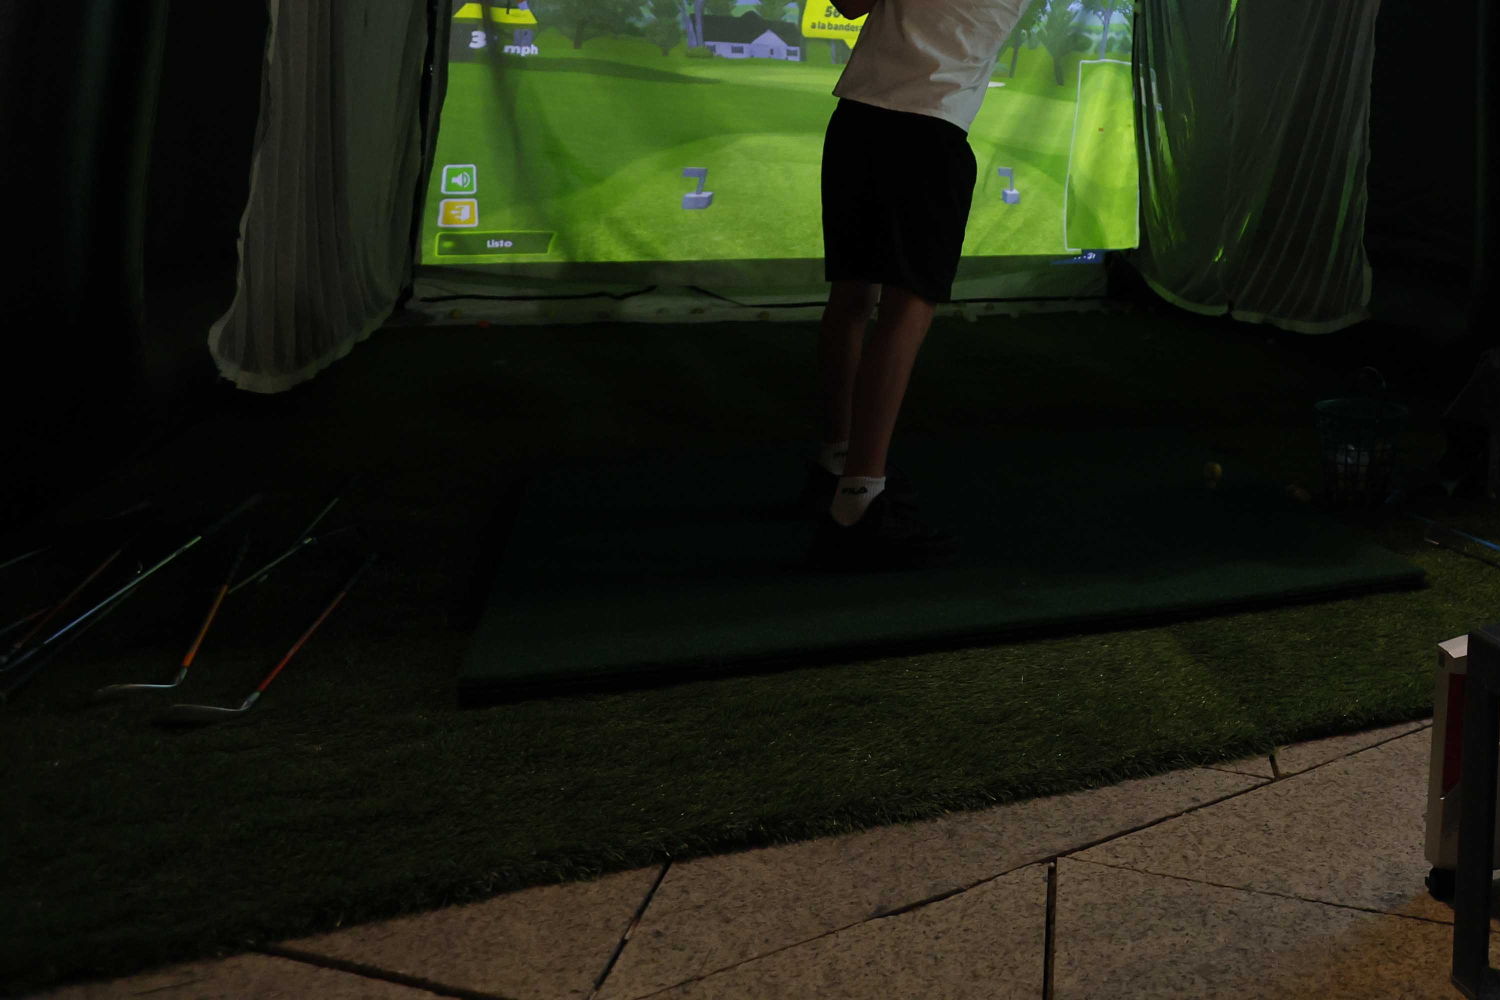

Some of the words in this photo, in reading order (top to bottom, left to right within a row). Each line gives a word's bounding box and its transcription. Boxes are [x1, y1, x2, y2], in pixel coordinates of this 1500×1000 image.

[818, 21, 826, 30] la
[827, 22, 863, 31] bander
[502, 44, 539, 57] mph
[486, 239, 513, 248] Listo
